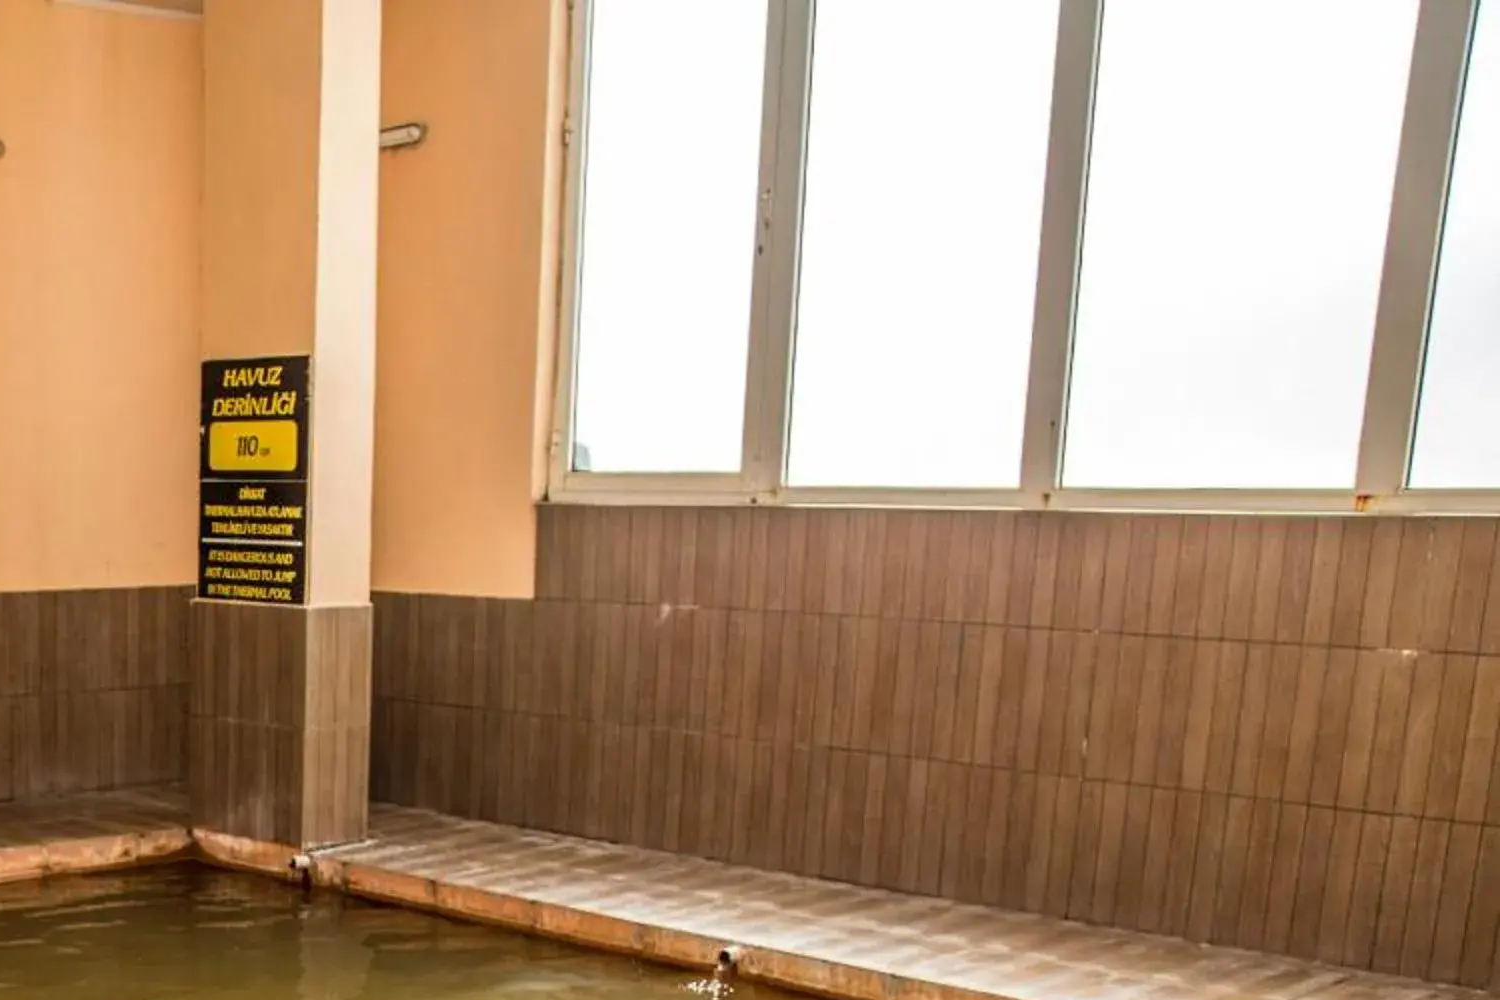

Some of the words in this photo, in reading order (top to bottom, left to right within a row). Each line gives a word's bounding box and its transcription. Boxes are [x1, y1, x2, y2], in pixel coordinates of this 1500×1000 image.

[223, 366, 283, 387] HAVUZ
[212, 391, 297, 416] DERİNLİĞİ
[237, 435, 259, 456] 110
[276, 552, 293, 564] AND
[222, 568, 260, 580] ALLOWED
[261, 569, 273, 580] TO
[275, 570, 297, 583] JUMP
[268, 587, 292, 600] POOL
